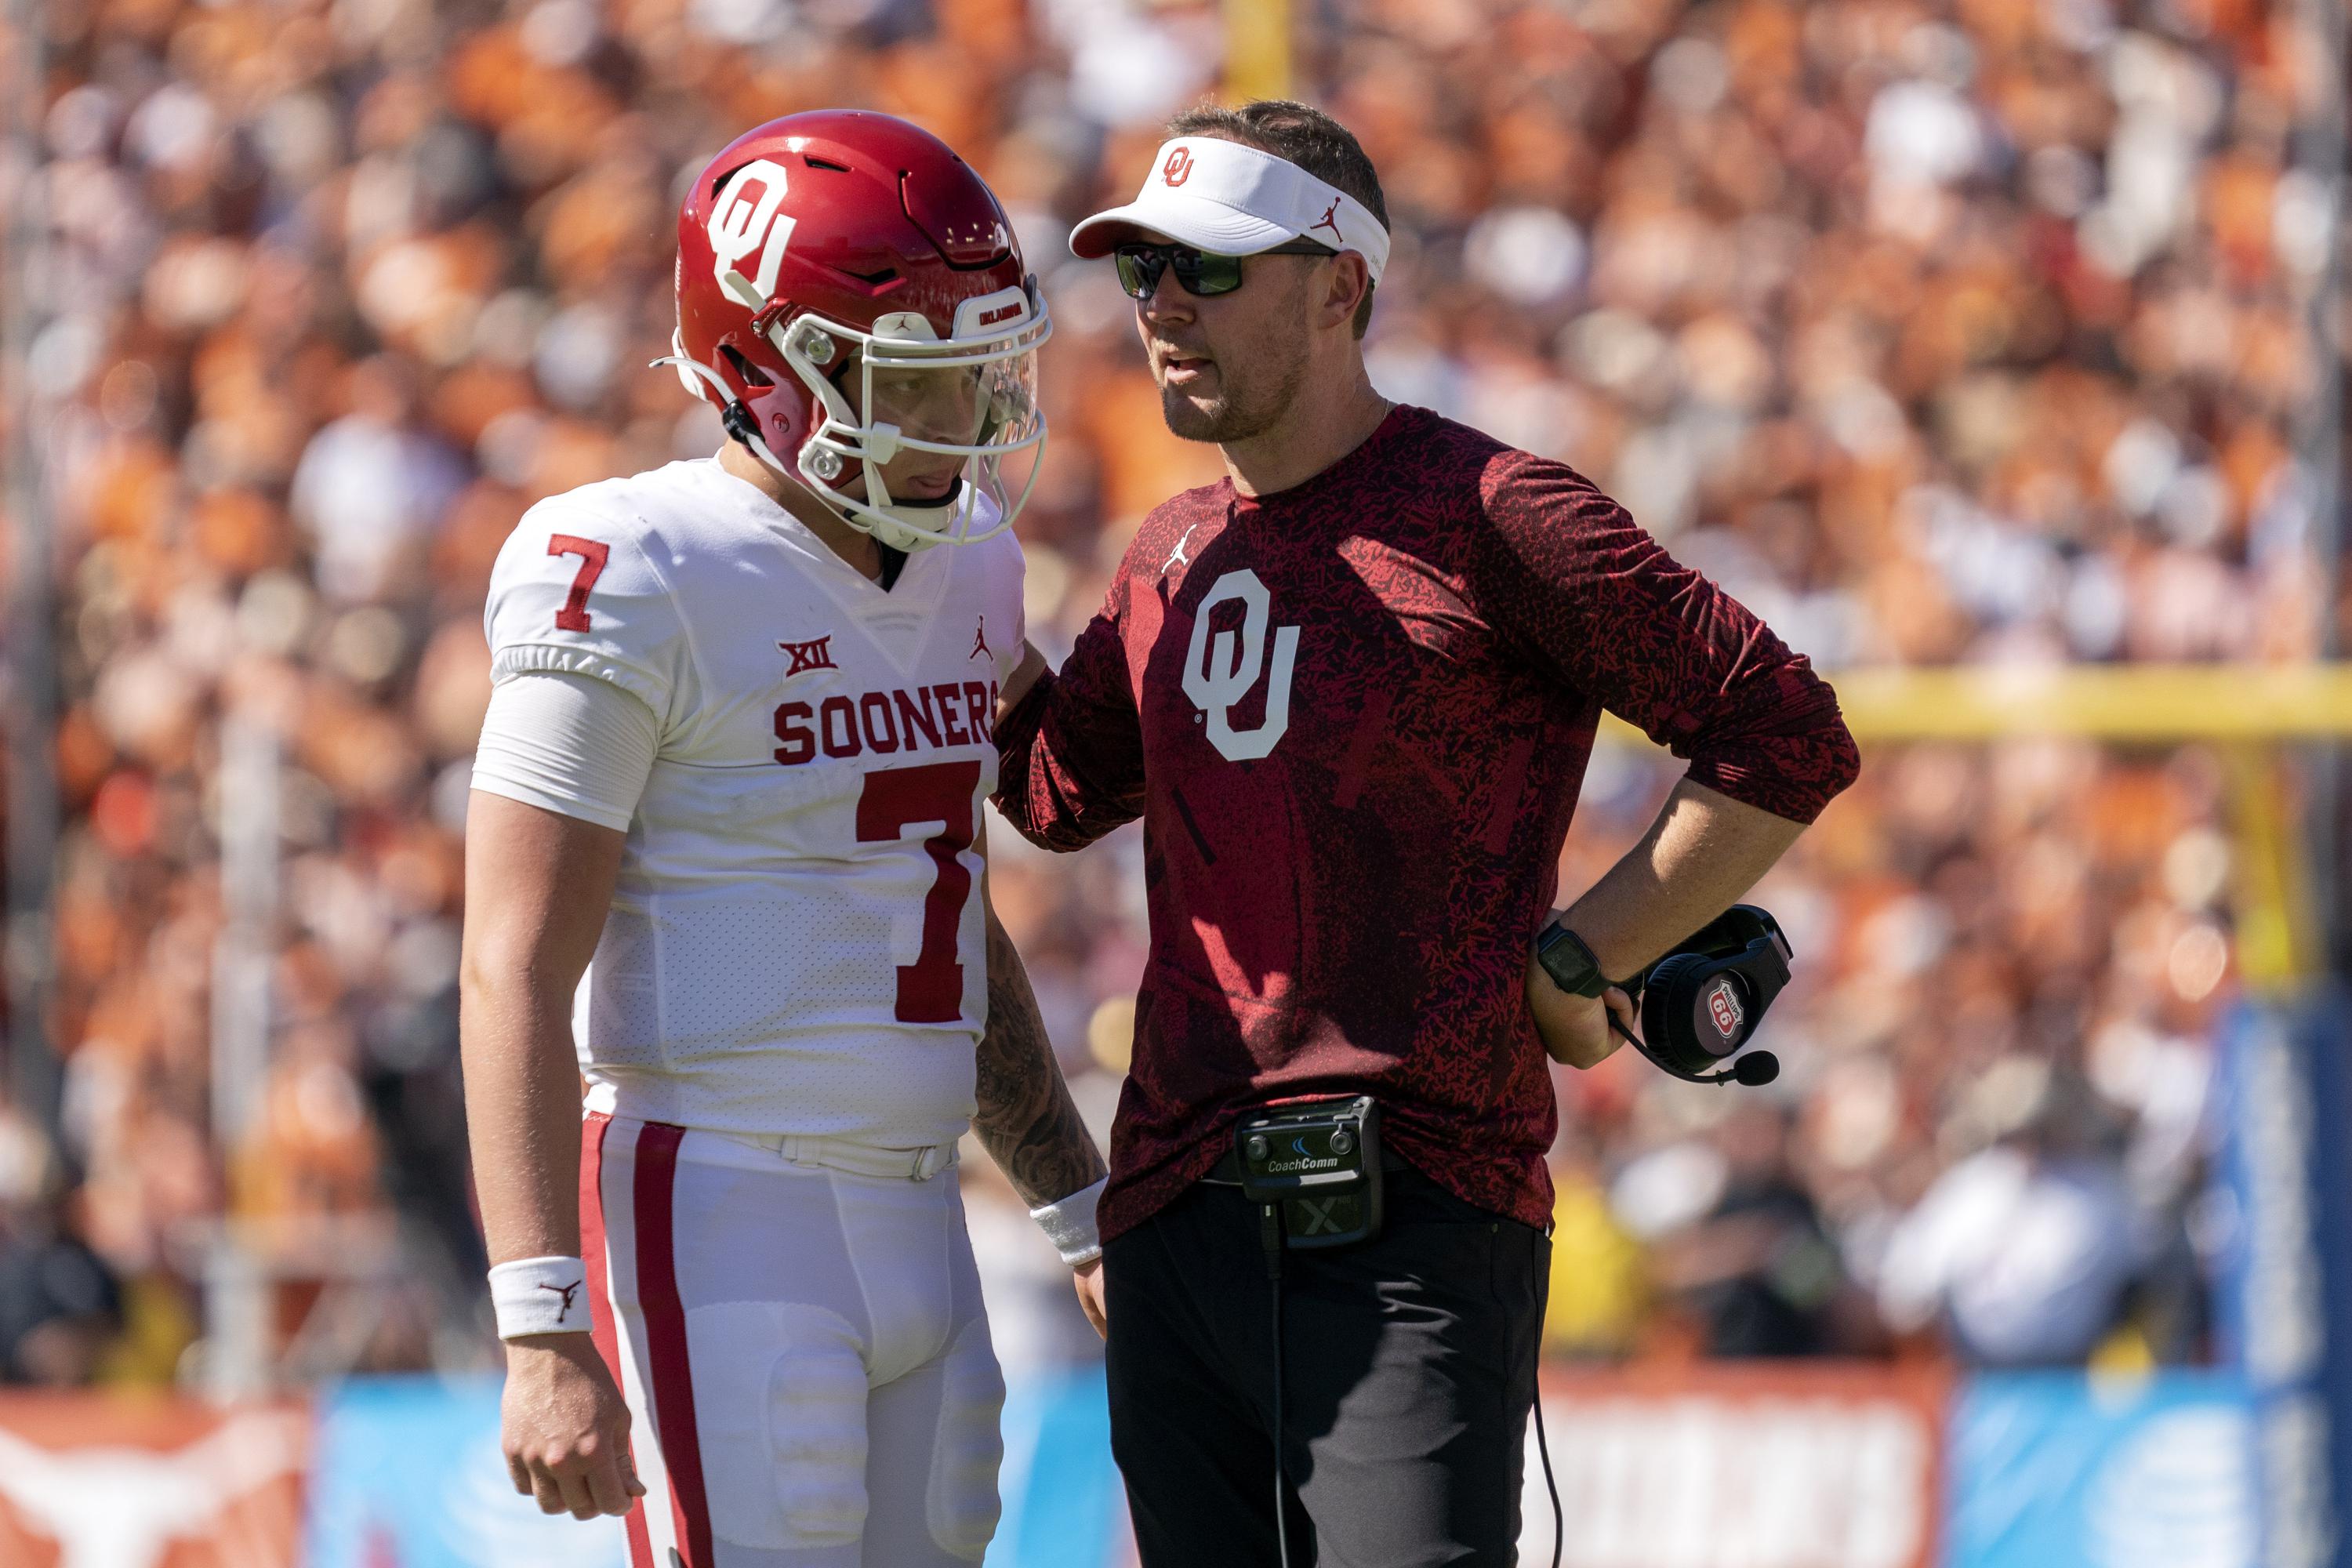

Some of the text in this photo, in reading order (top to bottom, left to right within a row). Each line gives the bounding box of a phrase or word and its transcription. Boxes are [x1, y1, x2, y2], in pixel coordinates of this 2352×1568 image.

[1163, 146, 1194, 187] OU
[707, 159, 797, 308] OU
[547, 534, 609, 633] 7
[1181, 568, 1301, 761] OU
[855, 760, 982, 1023] 7
[1714, 999, 1733, 1025] 66
[1722, 986, 1740, 1019] PHILLIPS
[1269, 1158, 1338, 1172] CoachComm
[1297, 1197, 1342, 1236] X
